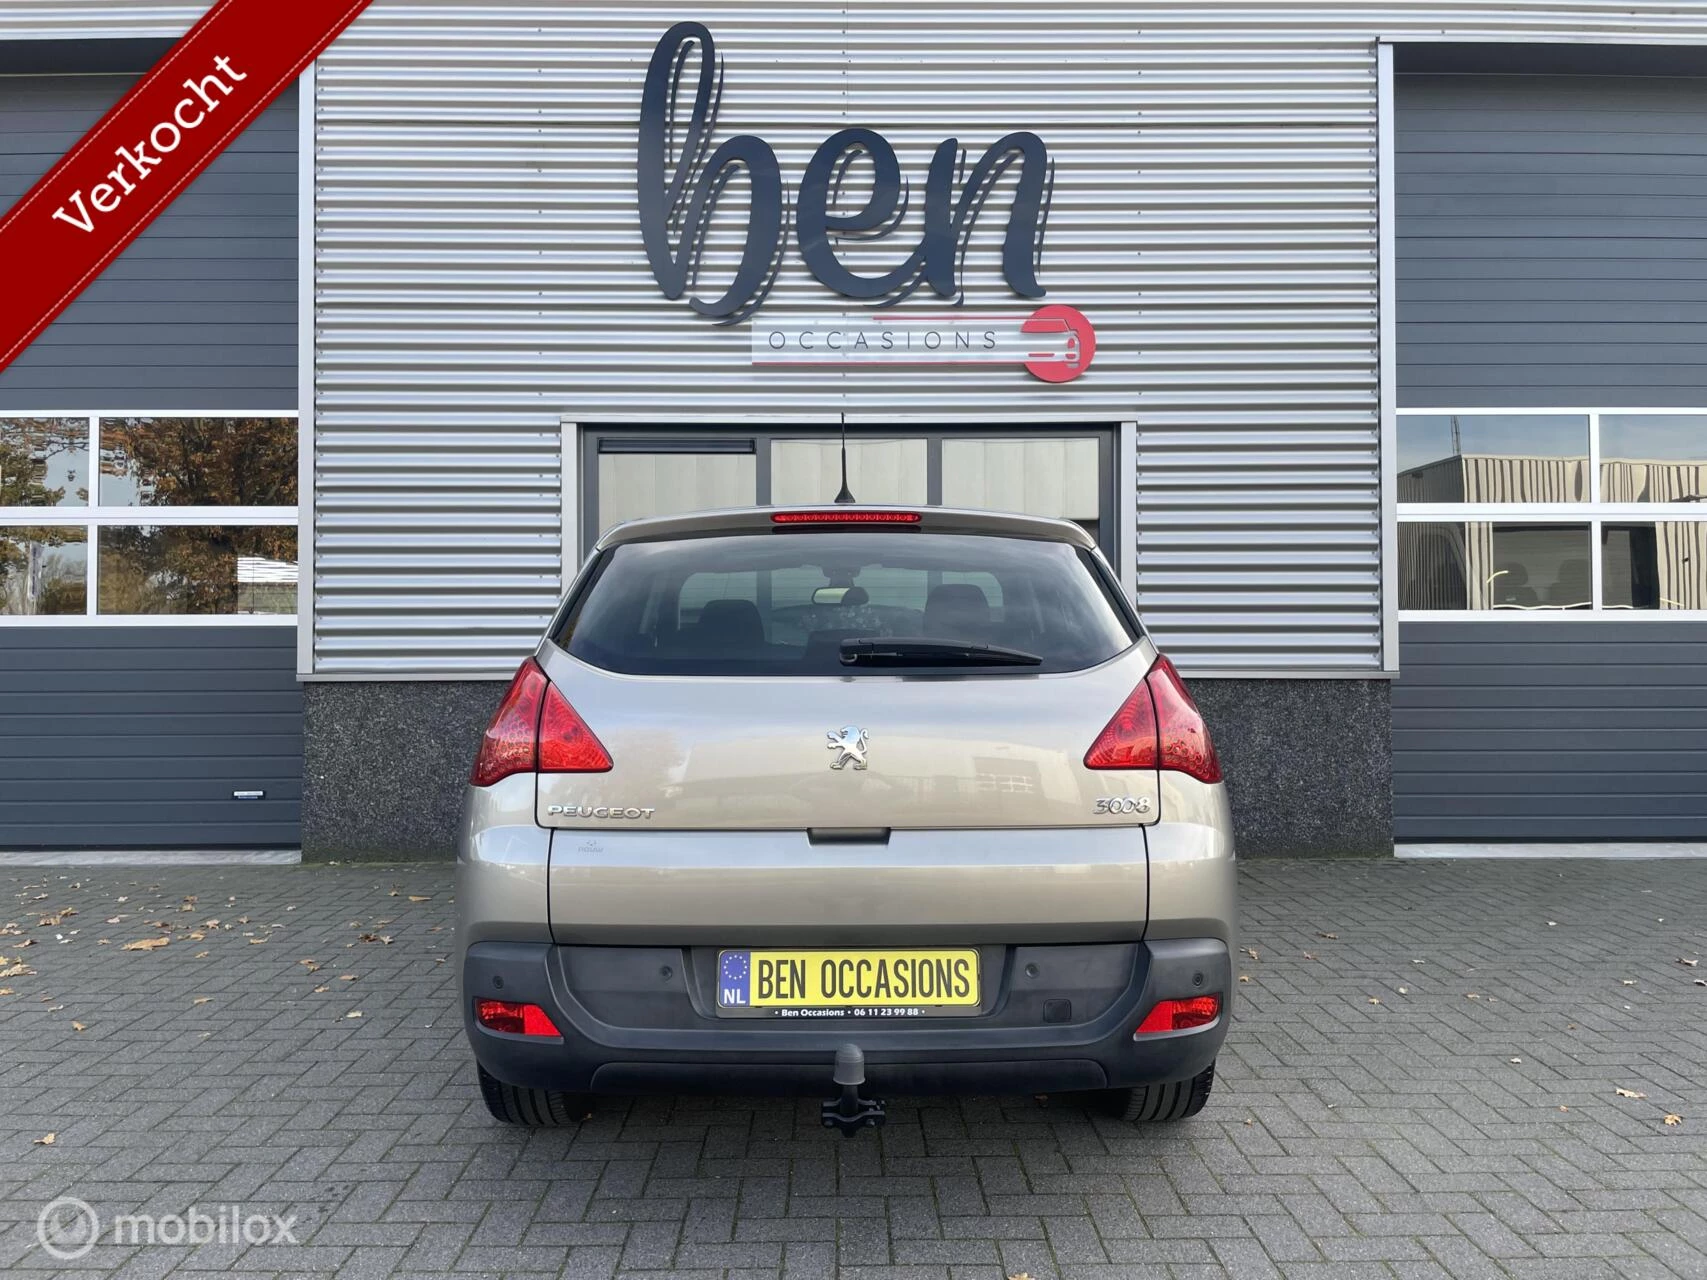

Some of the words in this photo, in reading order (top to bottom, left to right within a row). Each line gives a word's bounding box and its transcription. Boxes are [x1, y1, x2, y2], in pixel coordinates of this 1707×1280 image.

[637, 21, 1054, 324] ben
[768, 331, 997, 350] OCCASIONS
[547, 805, 655, 819] PEUGEOT
[1094, 797, 1151, 814] 3008
[758, 960, 806, 999] BEN
[821, 959, 970, 999] OCCASIONS
[723, 988, 746, 1005] NL
[781, 1009, 799, 1017] Ben
[800, 1009, 845, 1017] Occasions
[854, 1008, 866, 1016] 06
[868, 1008, 879, 1016] 11
[880, 1008, 893, 1016] 23
[894, 1008, 906, 1016] 99
[907, 1008, 919, 1016] 88
